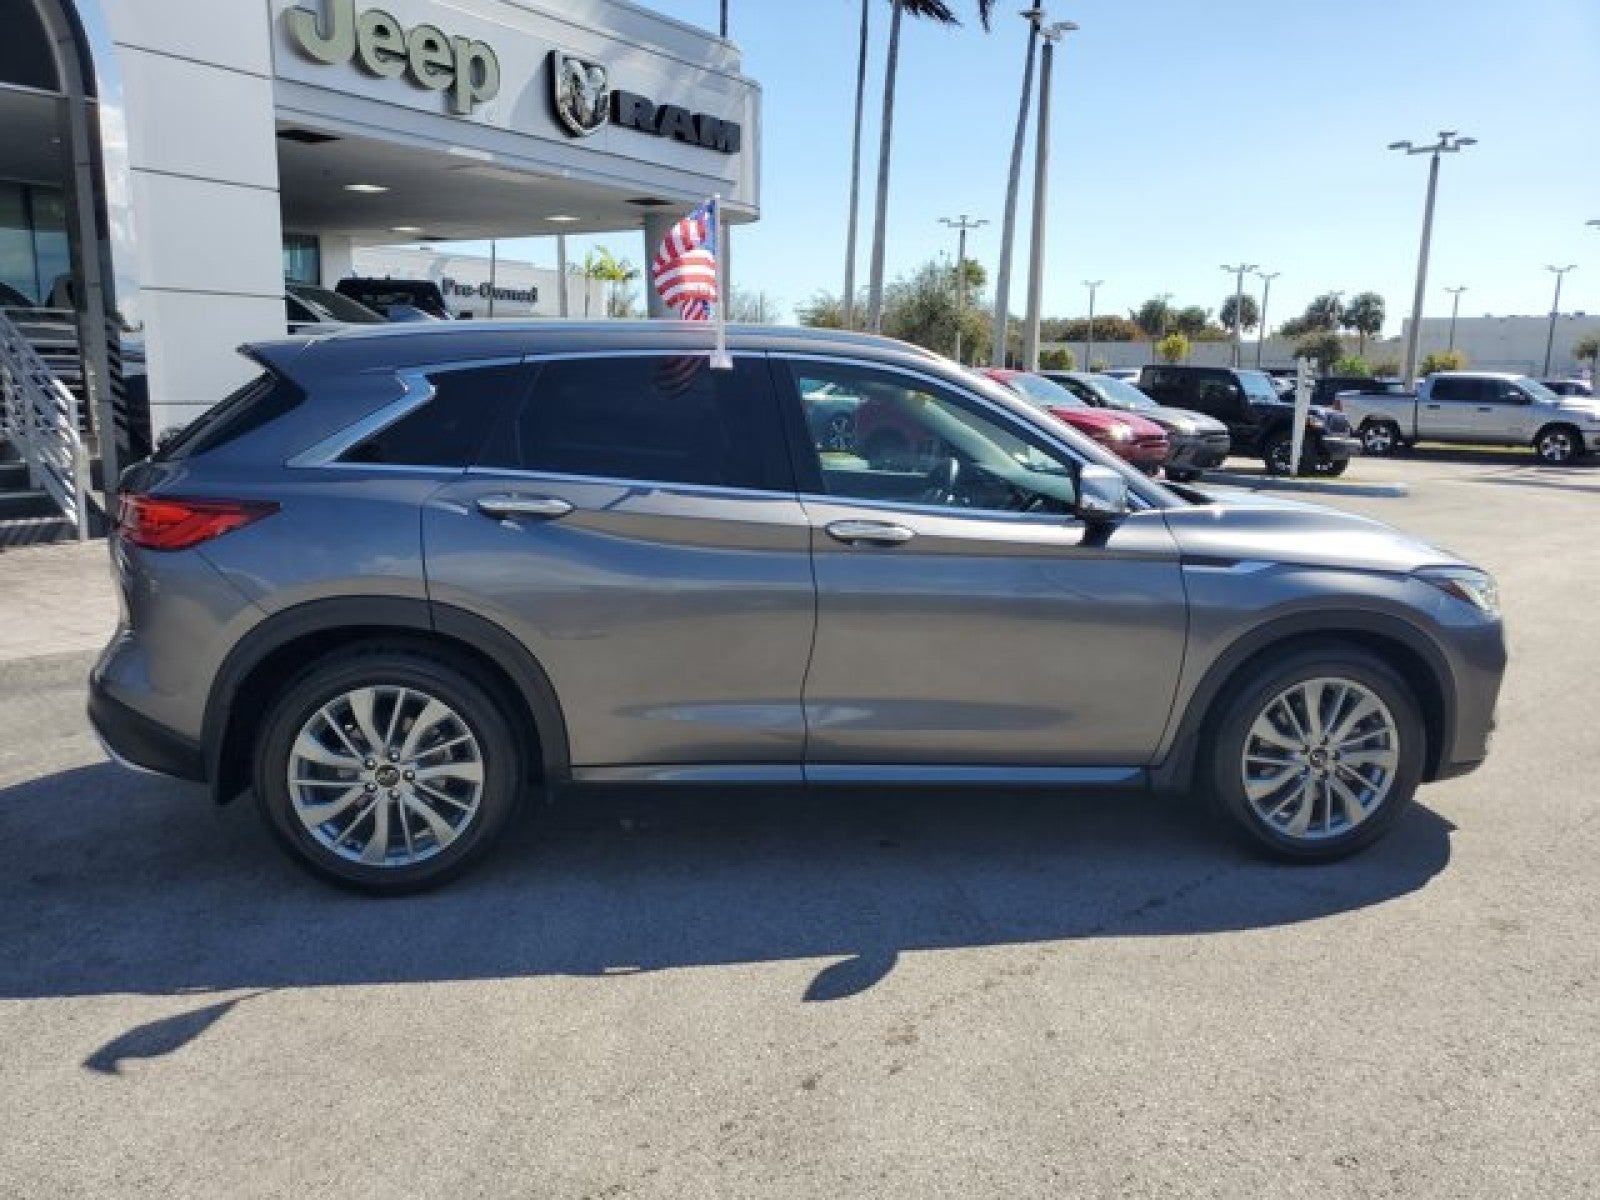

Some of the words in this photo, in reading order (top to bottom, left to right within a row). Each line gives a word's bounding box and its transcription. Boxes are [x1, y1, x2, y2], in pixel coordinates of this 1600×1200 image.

[284, 0, 500, 114] Jeep
[610, 90, 741, 154] RAM
[442, 278, 538, 303] Pre-Owned
